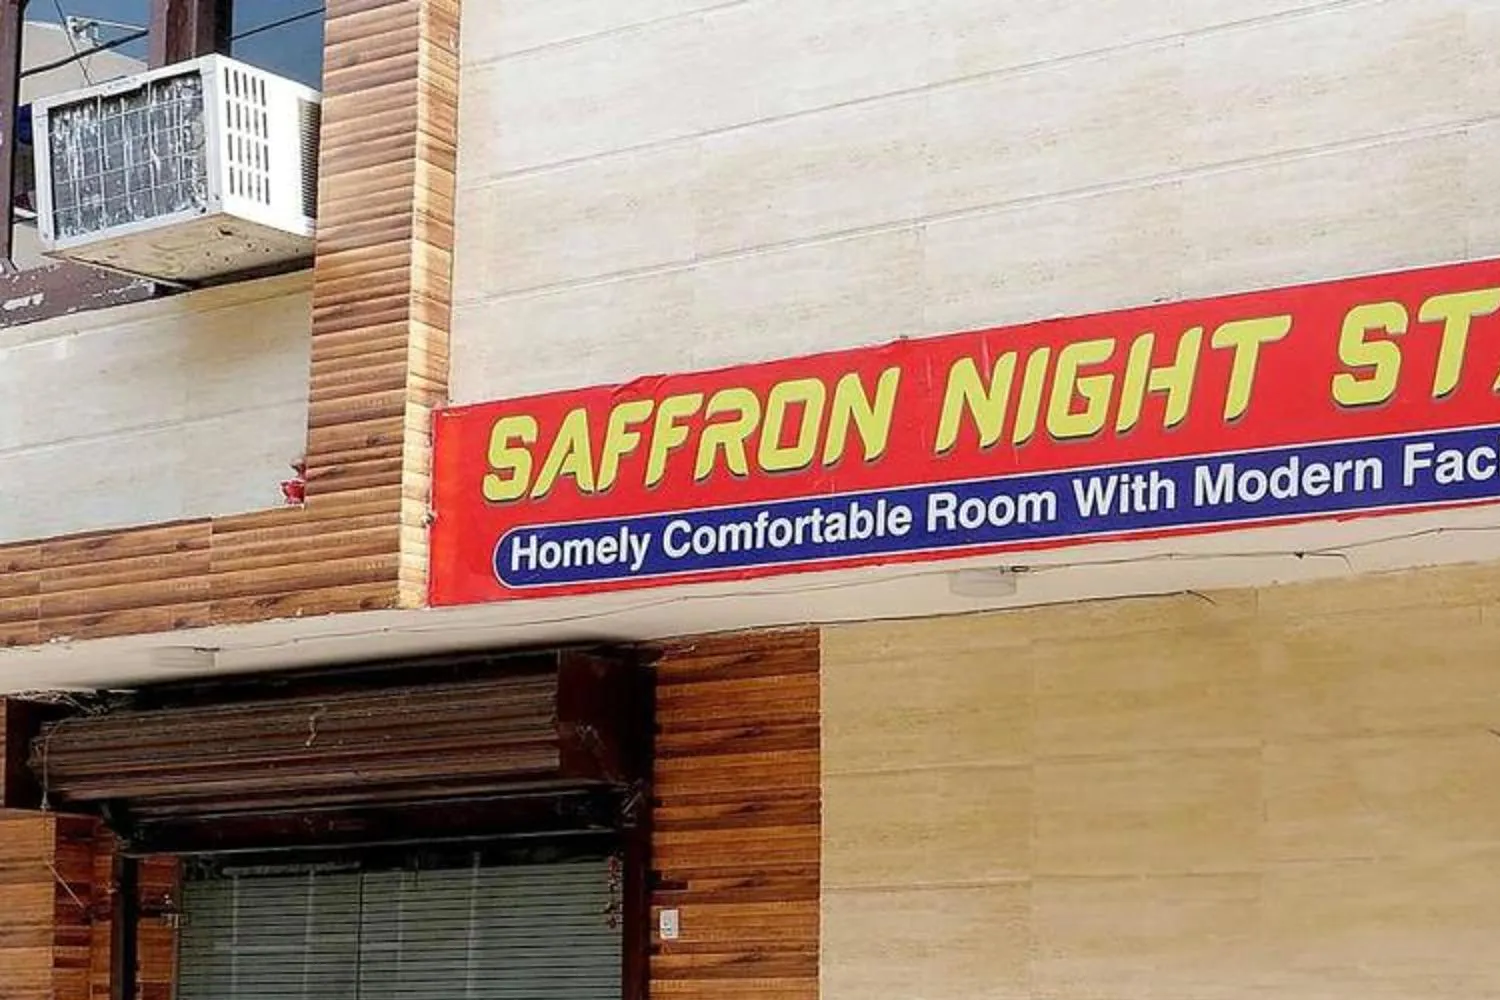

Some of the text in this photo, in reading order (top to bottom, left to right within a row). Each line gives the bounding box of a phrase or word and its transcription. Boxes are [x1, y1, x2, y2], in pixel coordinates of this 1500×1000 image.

[480, 365, 902, 504] SAFFRON
[934, 313, 1293, 455] NIGHT
[509, 530, 651, 574] Homely
[662, 494, 914, 560] Comfortable
[926, 484, 1056, 532] Room
[1073, 470, 1177, 519] With
[1194, 451, 1384, 508] Modern
